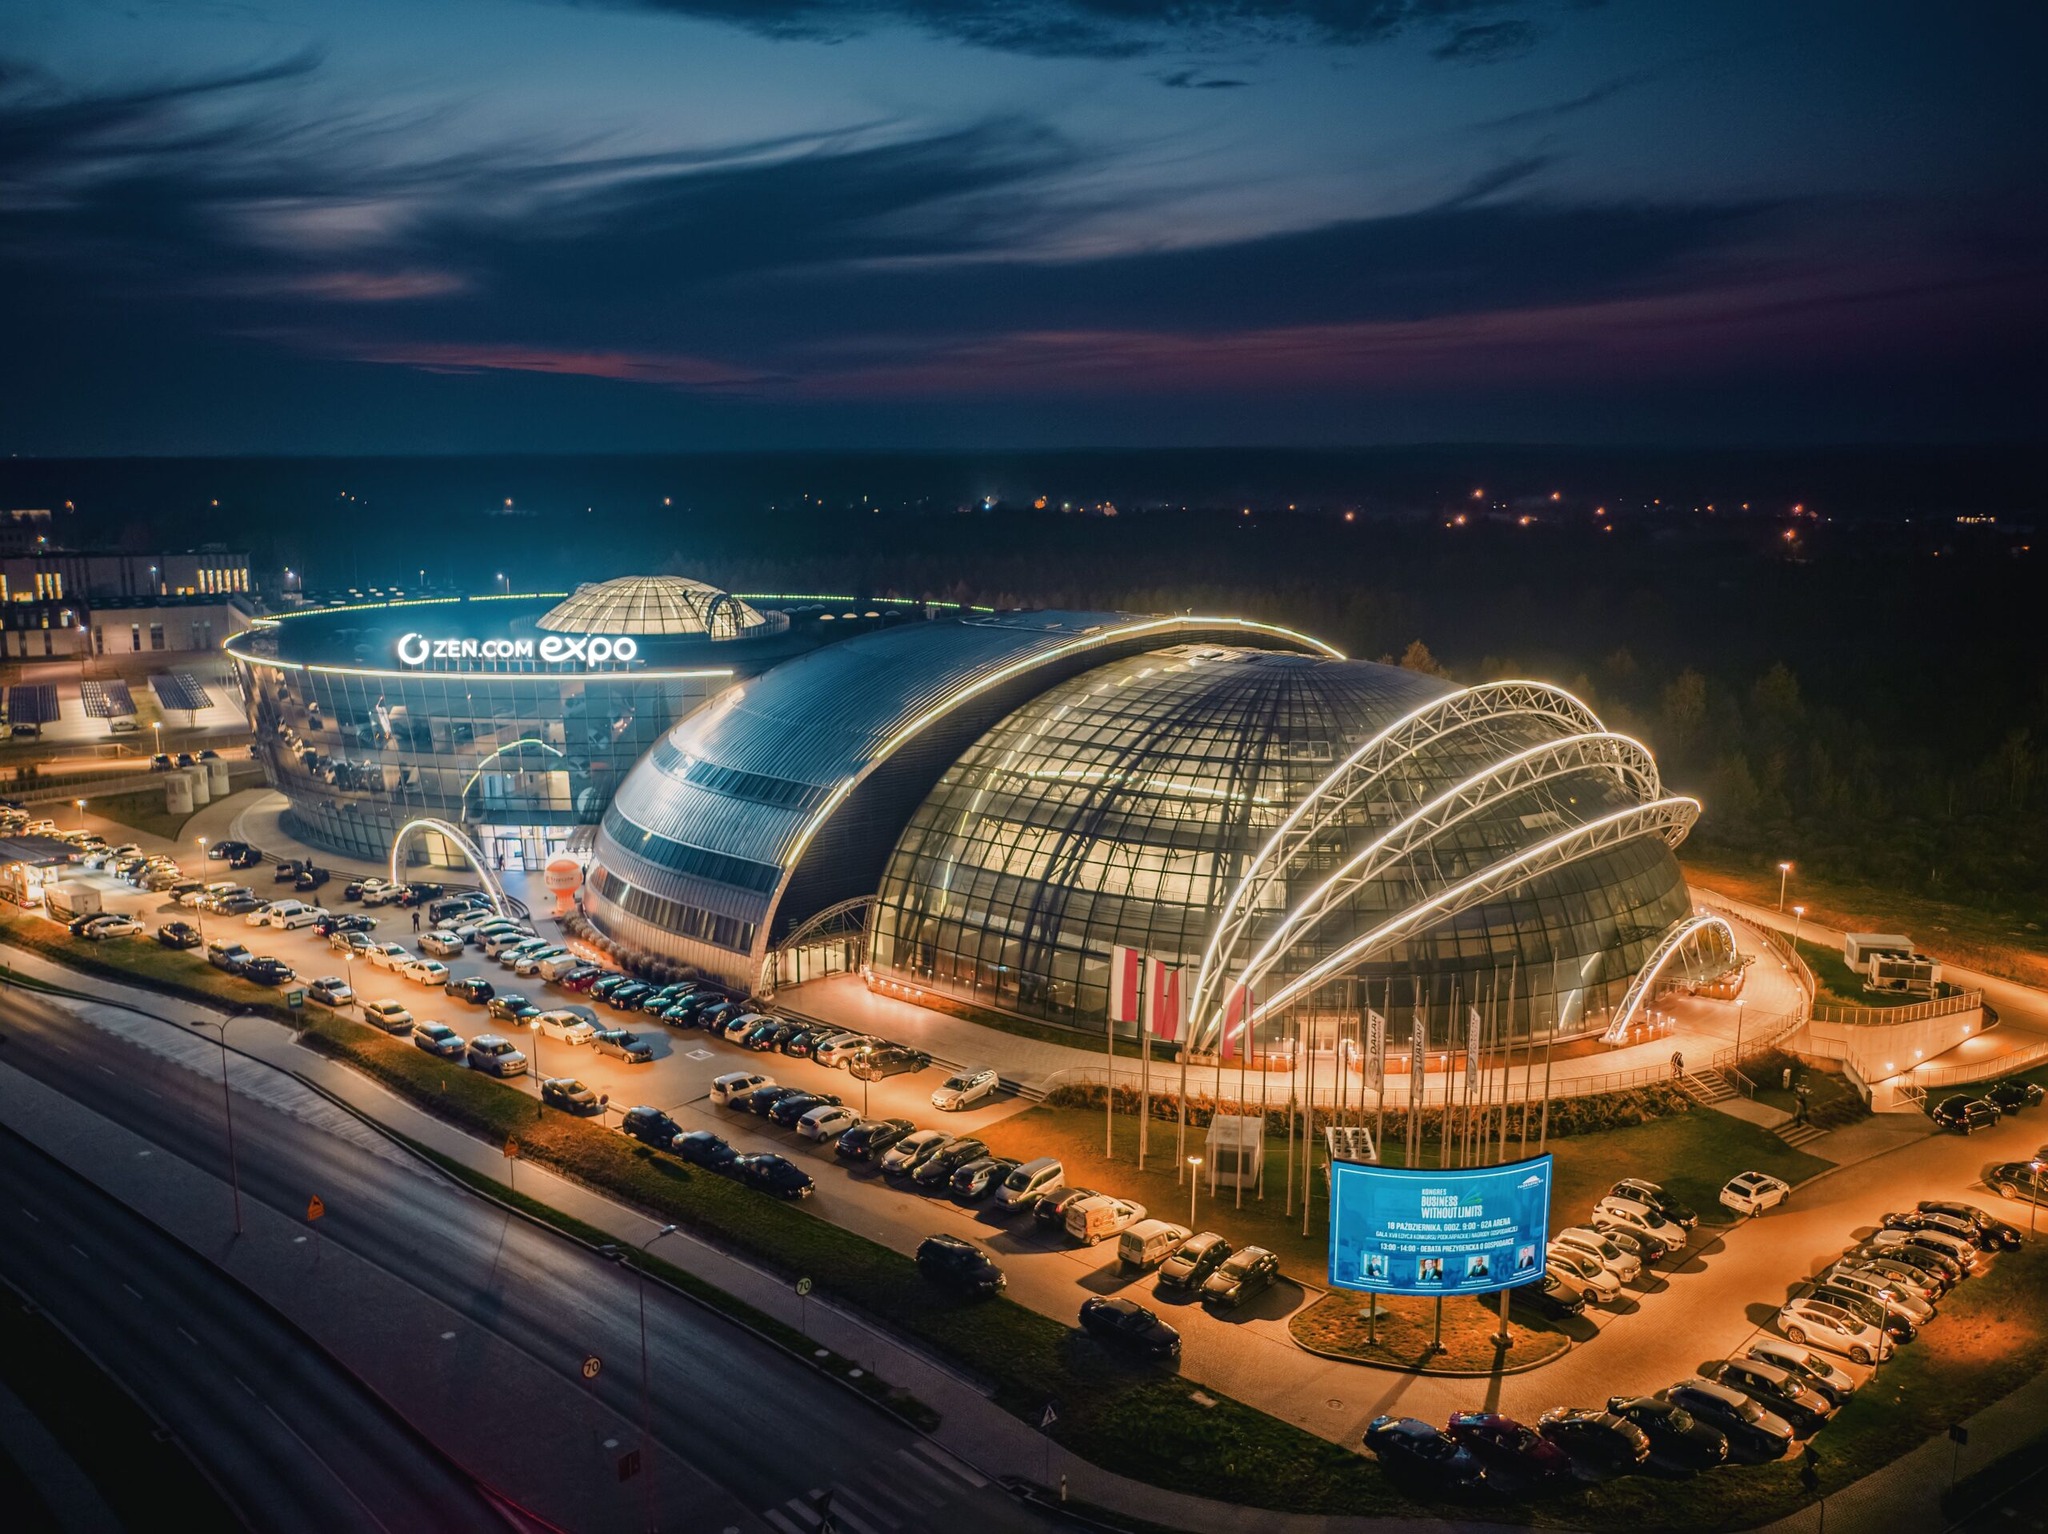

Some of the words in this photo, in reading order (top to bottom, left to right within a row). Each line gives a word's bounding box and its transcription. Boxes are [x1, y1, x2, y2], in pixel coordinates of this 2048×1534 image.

[433, 640, 533, 658] ZEN.COM
[539, 634, 637, 667] expo
[1421, 1195, 1458, 1206] BUSINESS
[1421, 1207, 1458, 1218] WITHOUT
[1458, 1205, 1482, 1218] LIMITS
[1462, 1222, 1476, 1230] 9:00
[1493, 1217, 1510, 1227] ARENA
[1380, 1242, 1396, 1250] 13:00
[1400, 1244, 1416, 1252] 14:00
[799, 1280, 810, 1293] 70
[585, 1360, 599, 1376] 70
